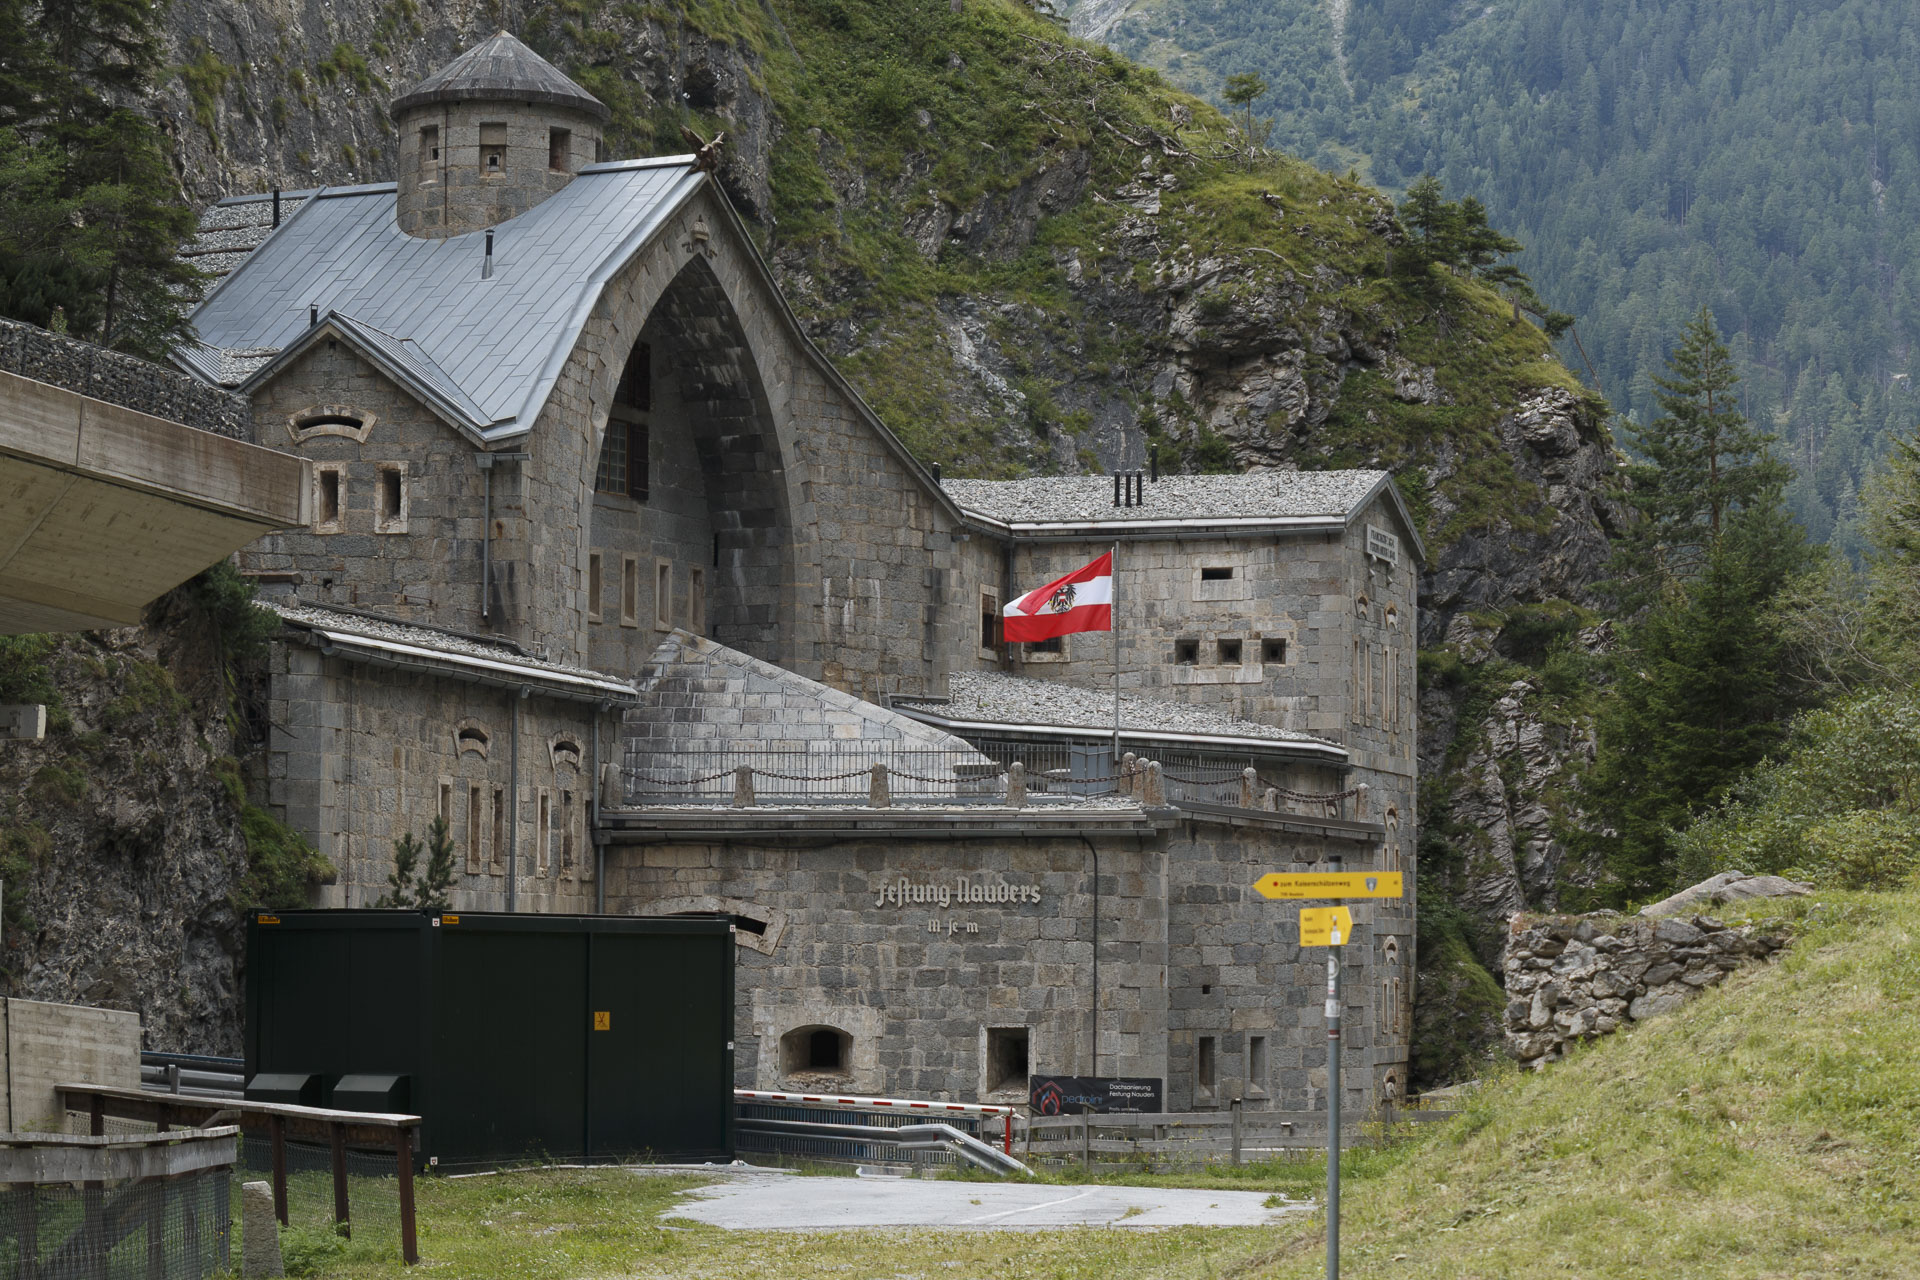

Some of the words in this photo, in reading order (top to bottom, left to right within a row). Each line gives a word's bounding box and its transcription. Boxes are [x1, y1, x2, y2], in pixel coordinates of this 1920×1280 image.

[957, 876, 1041, 904] Nauders
[1109, 1083, 1151, 1092] Dachsanierung
[1109, 1091, 1131, 1099] Festung
